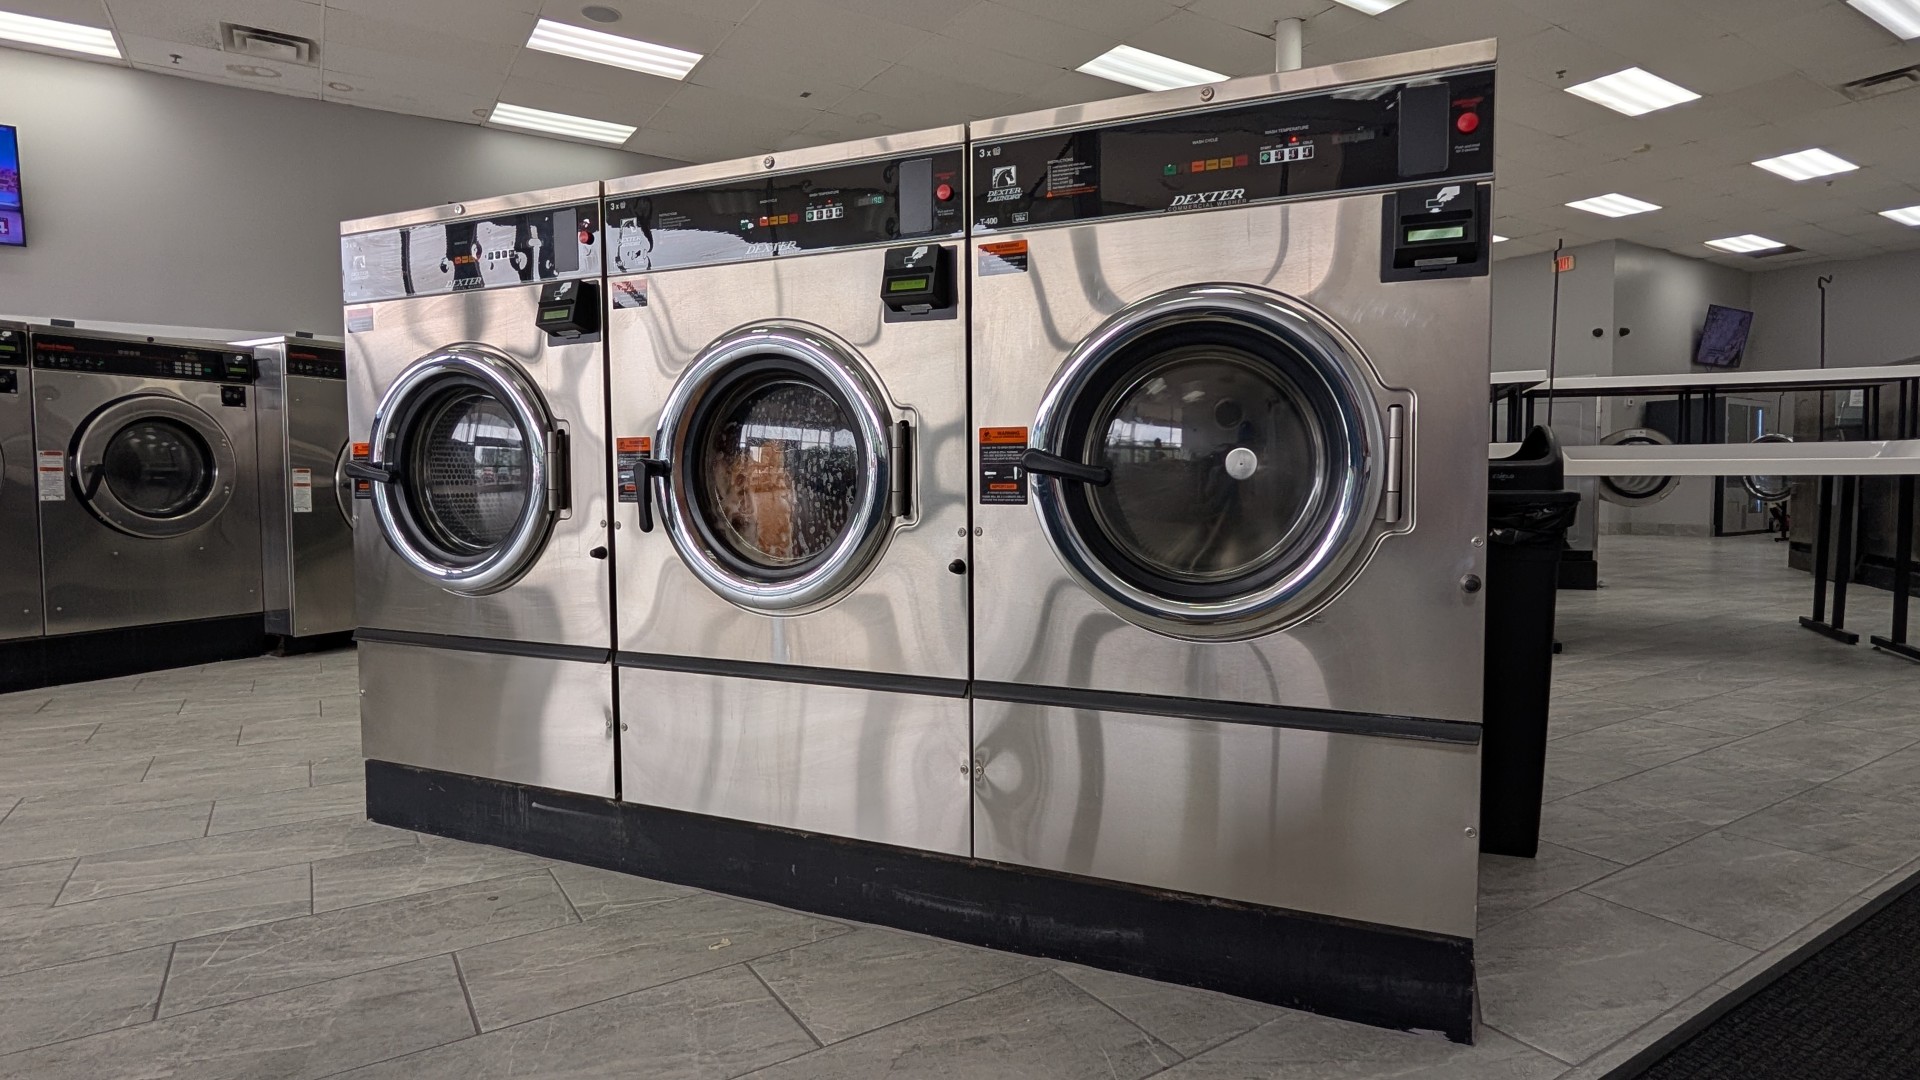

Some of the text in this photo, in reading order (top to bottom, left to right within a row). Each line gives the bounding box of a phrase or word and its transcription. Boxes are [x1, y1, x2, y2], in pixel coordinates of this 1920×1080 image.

[979, 149, 985, 158] 3
[988, 187, 1022, 197] DEXTER
[987, 193, 1022, 203] LAUNDRY
[1170, 188, 1245, 207] DEXTER
[1167, 198, 1247, 212] COMMERCIAL WASHER
[980, 217, 998, 225] T-400
[746, 241, 797, 254] DEXTER
[445, 277, 482, 288] DEXTER
